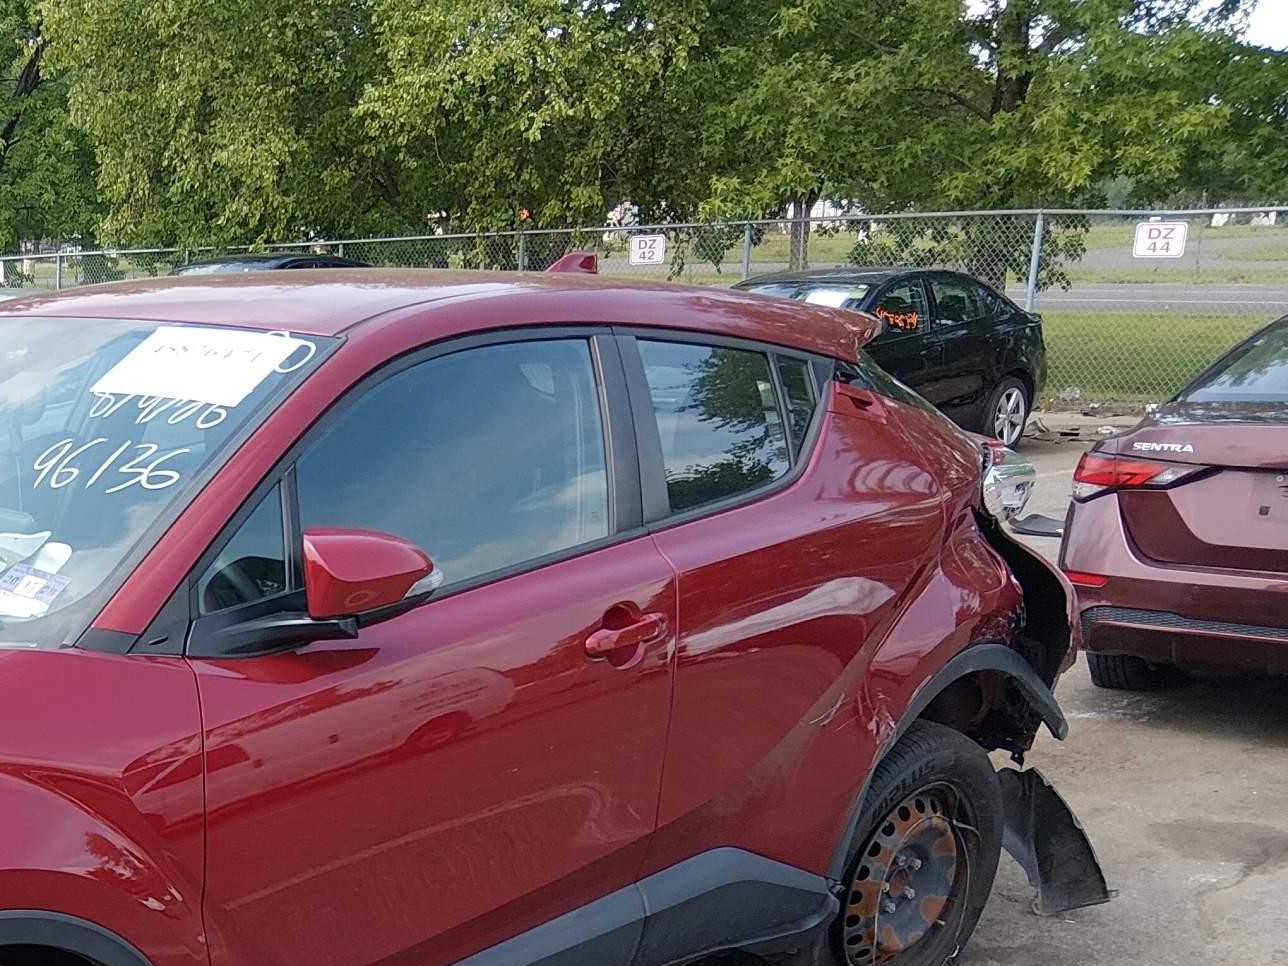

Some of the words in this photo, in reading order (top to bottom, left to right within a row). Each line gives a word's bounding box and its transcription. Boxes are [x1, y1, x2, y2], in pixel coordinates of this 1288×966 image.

[1147, 227, 1177, 240] DZ
[638, 239, 657, 250] DZ
[1146, 241, 1171, 253] 44
[639, 250, 656, 260] 42
[1132, 442, 1194, 454] SENTRA
